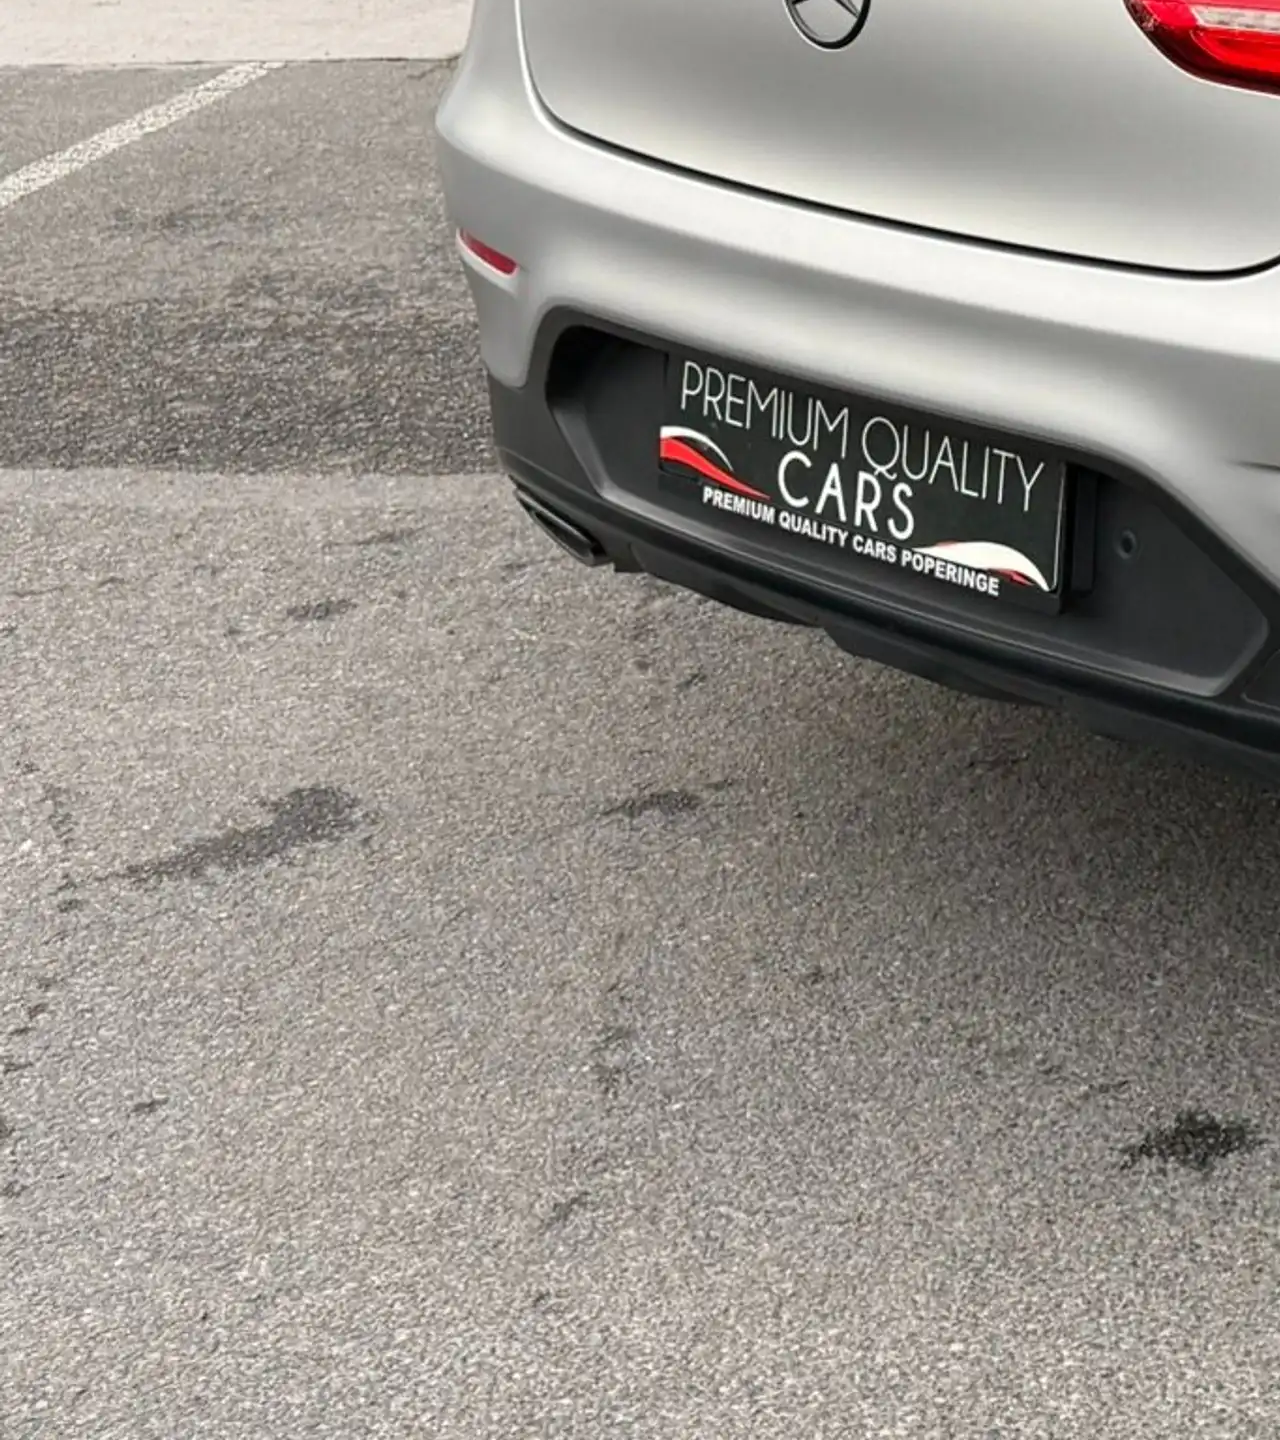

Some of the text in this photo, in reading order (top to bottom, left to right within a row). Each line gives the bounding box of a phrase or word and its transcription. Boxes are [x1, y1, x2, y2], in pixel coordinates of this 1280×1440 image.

[680, 360, 1045, 512] PREMIUM QUALITY
[702, 485, 1000, 597] PREMIUM QUALITY CARS POPERINGE
[777, 450, 915, 540] CARS
